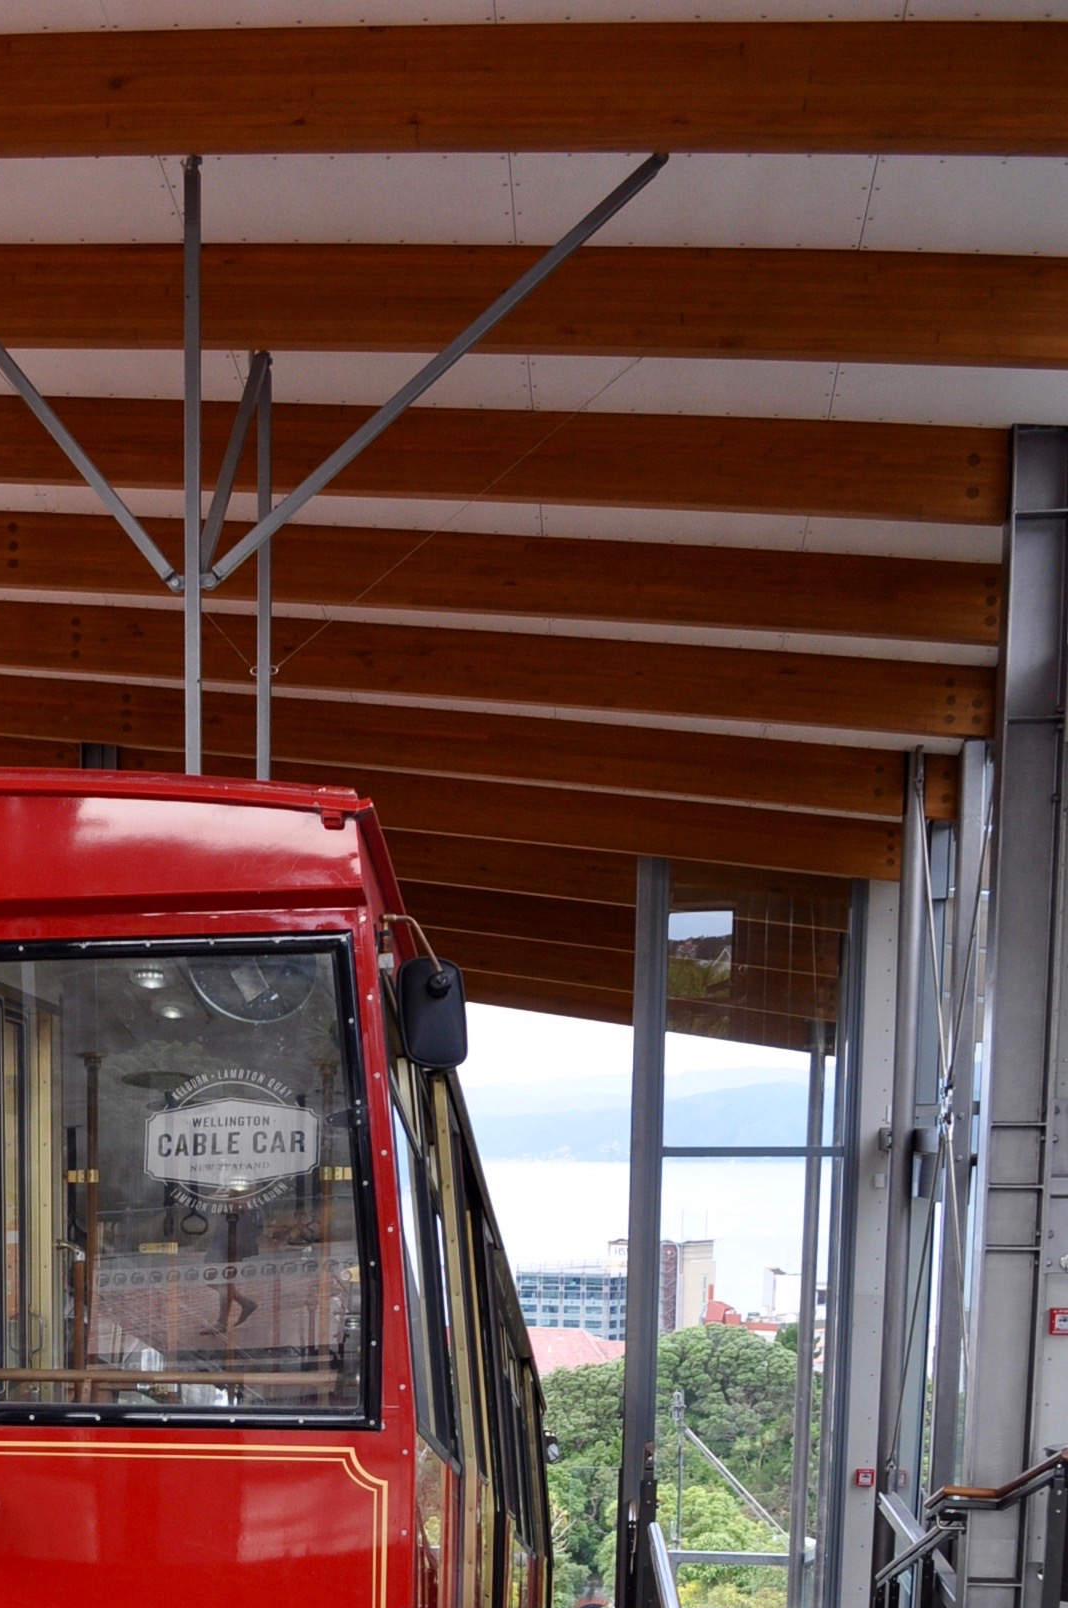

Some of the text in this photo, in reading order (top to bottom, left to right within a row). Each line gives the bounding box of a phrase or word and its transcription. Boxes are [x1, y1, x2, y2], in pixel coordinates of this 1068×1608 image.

[171, 1068, 293, 1101] KELBURN LAMBTON QUAY
[192, 1116, 270, 1128] WELLINGTON
[158, 1130, 306, 1157] CABLE CAR
[190, 1161, 270, 1173] NEW ZEALAND
[170, 1182, 289, 1214] LAMBTON QUAY KELBURN
